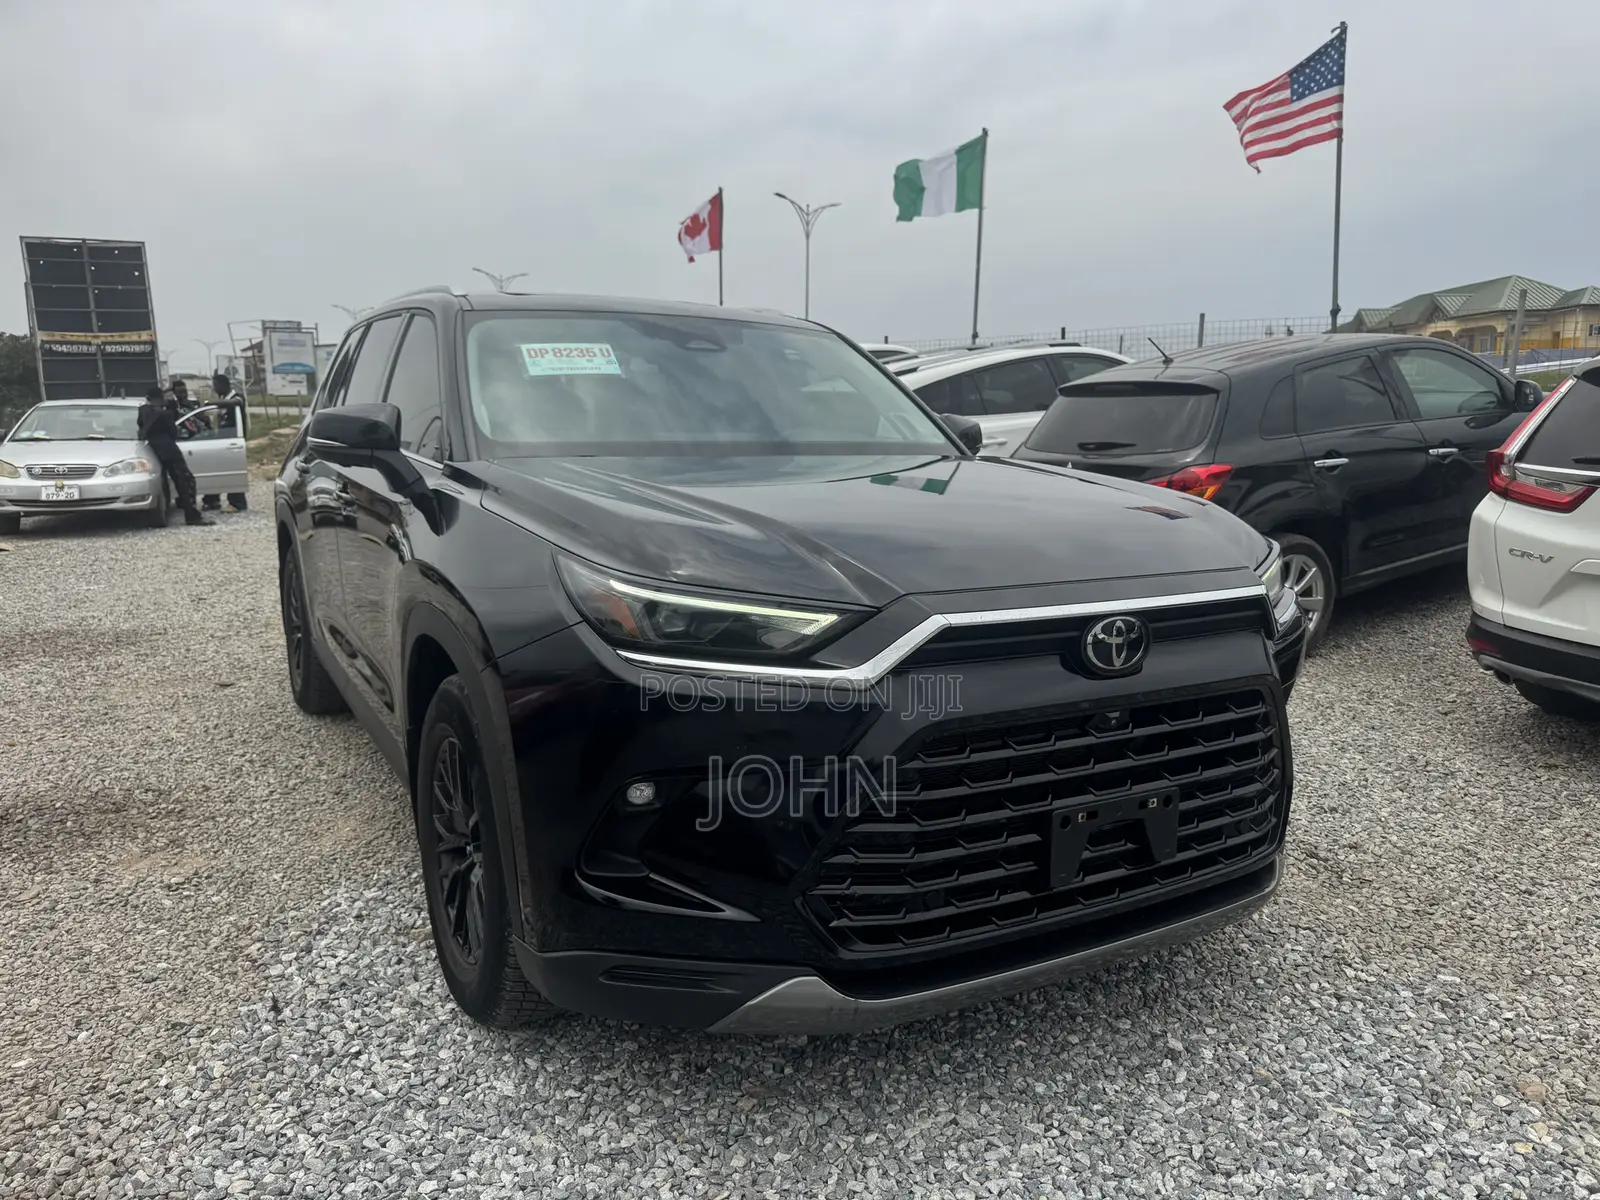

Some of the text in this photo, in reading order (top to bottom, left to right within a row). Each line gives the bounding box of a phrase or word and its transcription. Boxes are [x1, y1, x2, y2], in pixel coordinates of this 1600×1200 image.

[525, 347, 612, 359] DP 8235 U
[1508, 547, 1555, 563] CR-V
